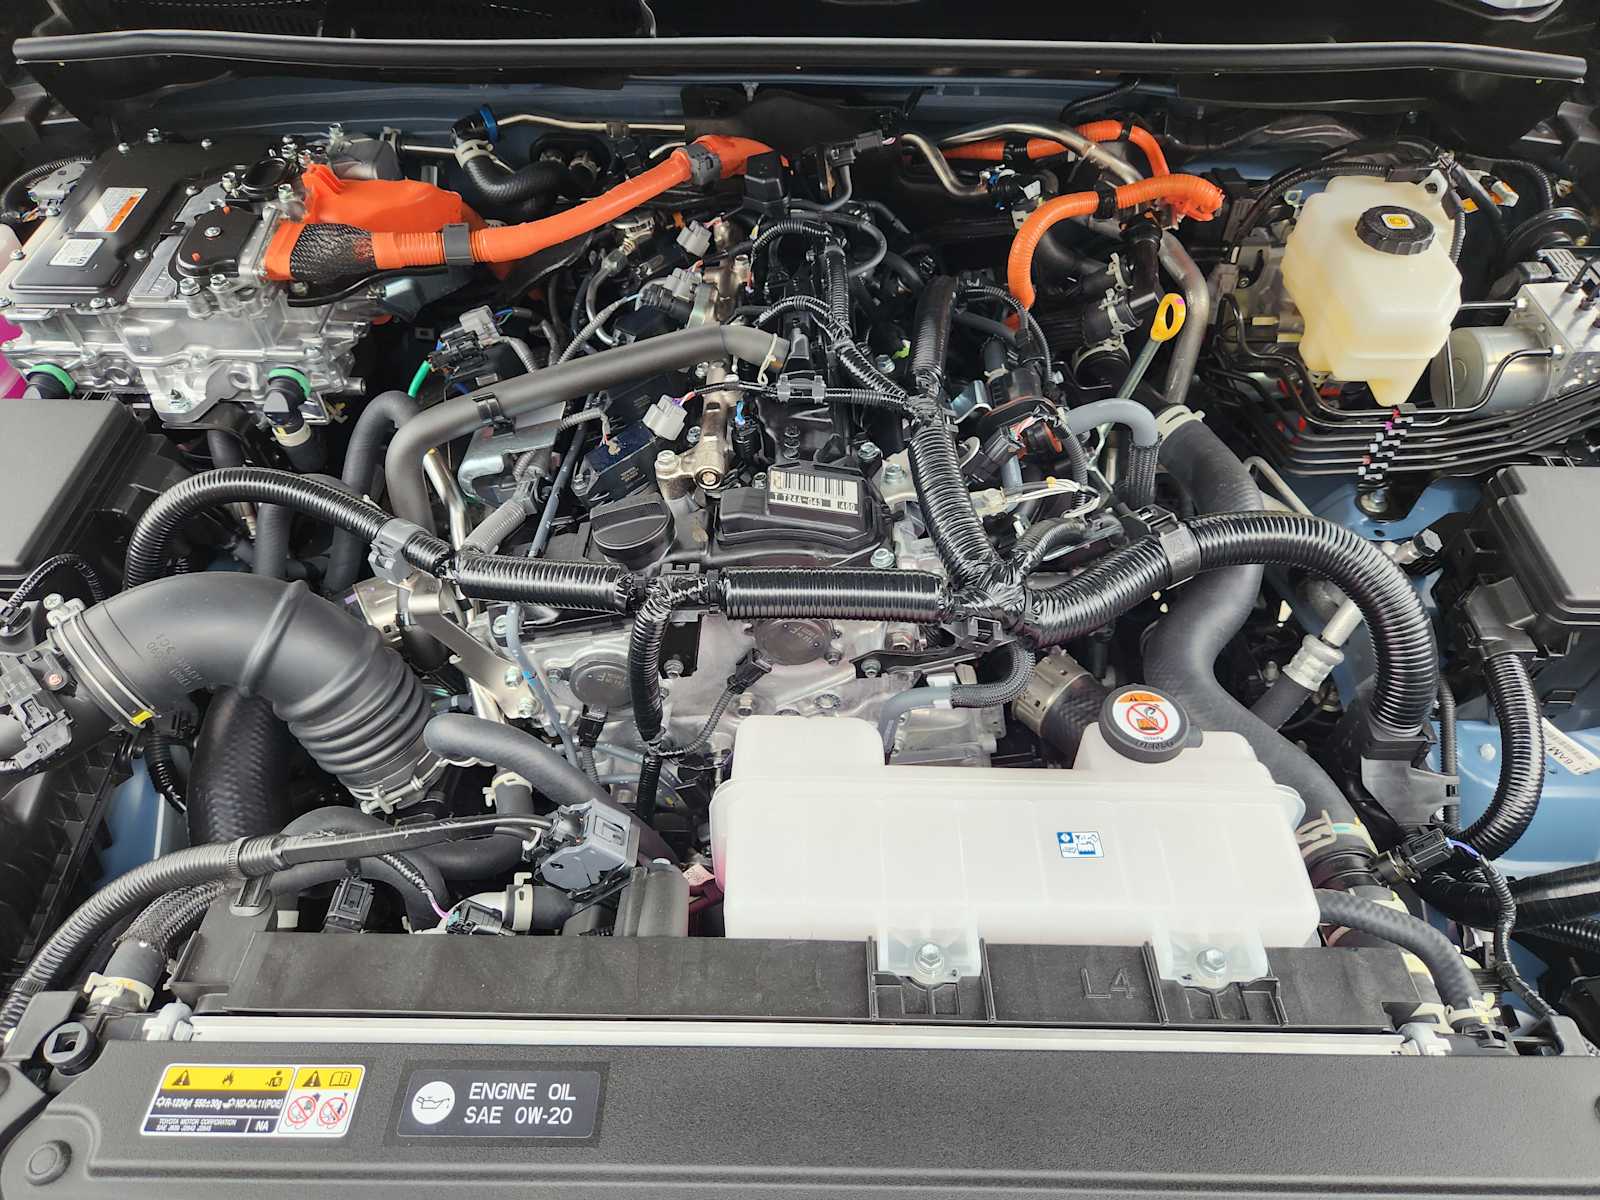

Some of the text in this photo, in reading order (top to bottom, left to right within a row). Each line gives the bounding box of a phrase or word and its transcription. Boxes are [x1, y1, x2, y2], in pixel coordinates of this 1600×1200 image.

[1080, 967, 1136, 1000] L4
[469, 1082, 577, 1101] ENGINE OIL
[464, 1106, 573, 1124] SAE 0W-20
[254, 1120, 269, 1132] NA
